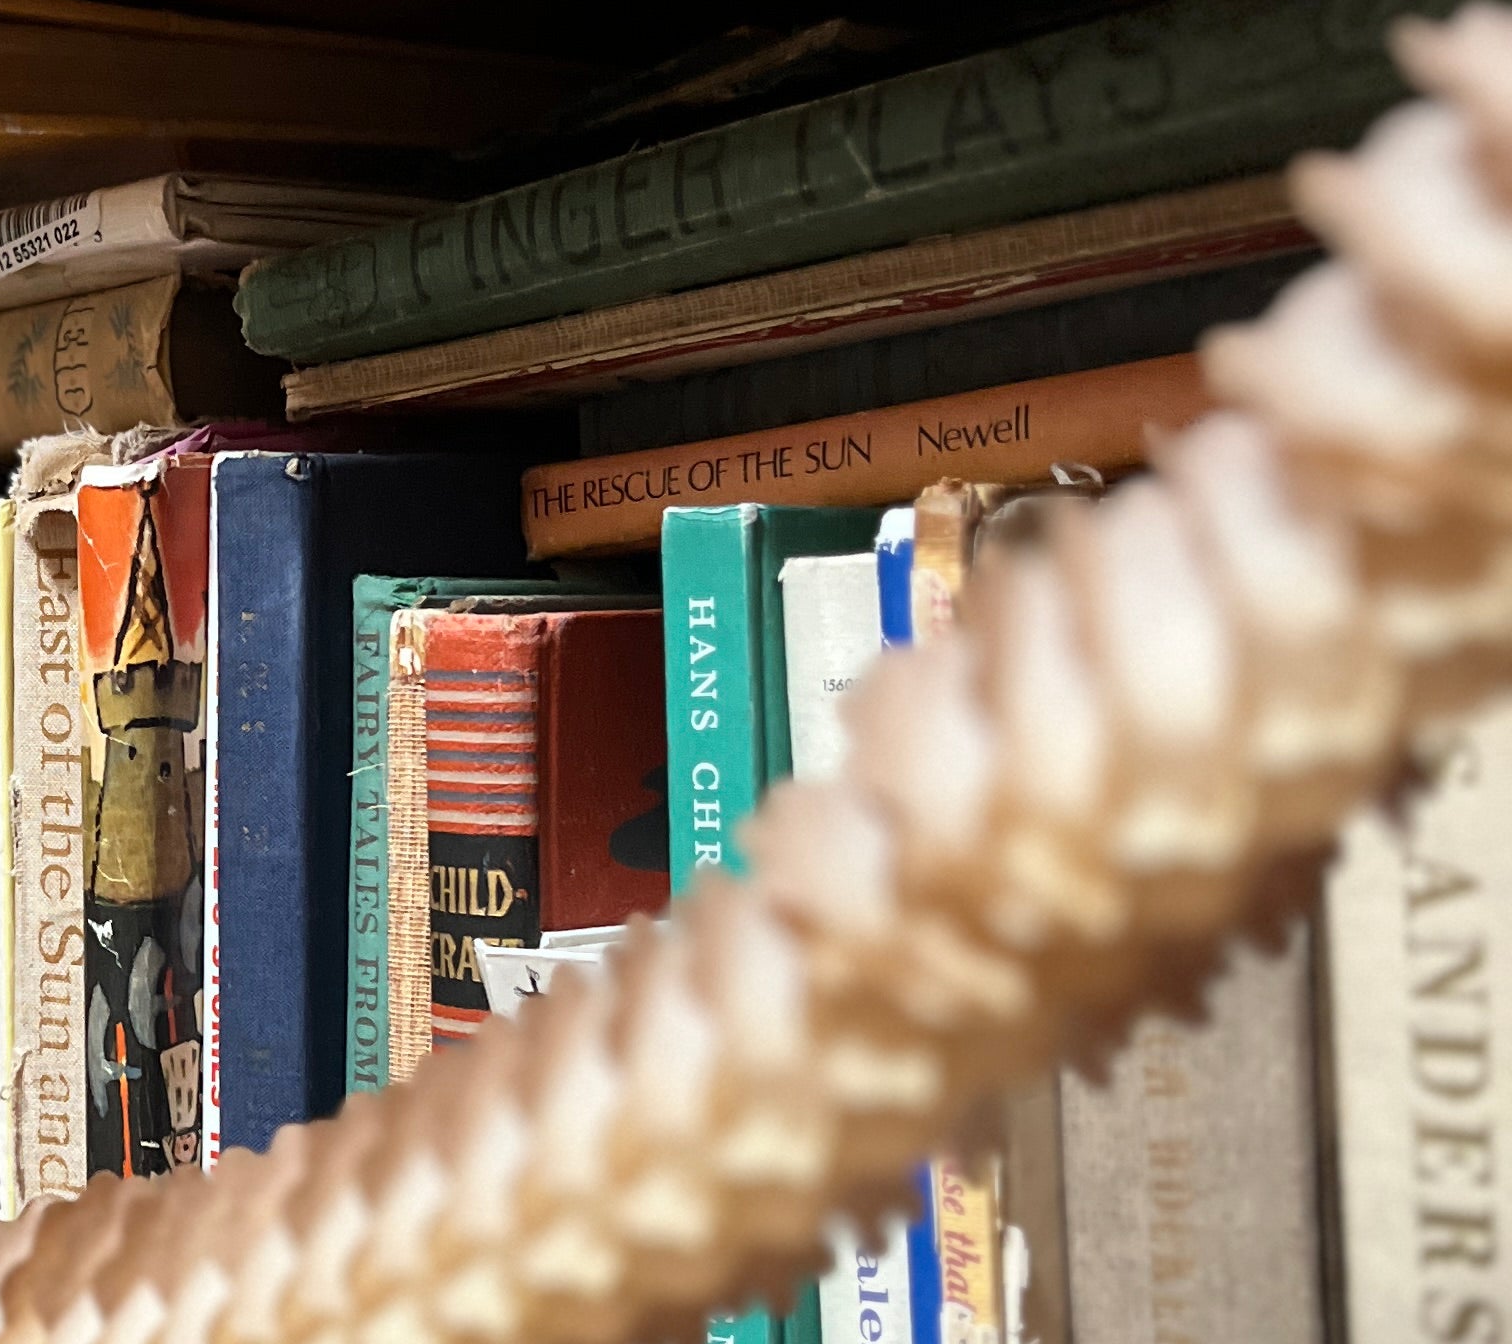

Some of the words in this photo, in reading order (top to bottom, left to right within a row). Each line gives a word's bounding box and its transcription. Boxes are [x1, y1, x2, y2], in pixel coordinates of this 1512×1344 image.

[14, 233, 53, 264] 55321
[54, 219, 80, 245] 022
[408, 138, 733, 306] FINGER
[532, 484, 575, 519] THE
[583, 463, 680, 507] RESCUE
[690, 458, 728, 491] OF
[737, 446, 792, 485] THE
[806, 434, 872, 472] SUN
[918, 405, 1029, 455] Newell
[37, 547, 78, 686] East
[689, 596, 719, 731] HANS
[38, 698, 83, 772] of
[355, 630, 383, 769] FAIRY
[38, 780, 84, 901] the
[355, 790, 383, 932] TALES
[38, 915, 84, 1050] Sun
[355, 962, 381, 1088] FROM
[38, 1067, 82, 1197] and
